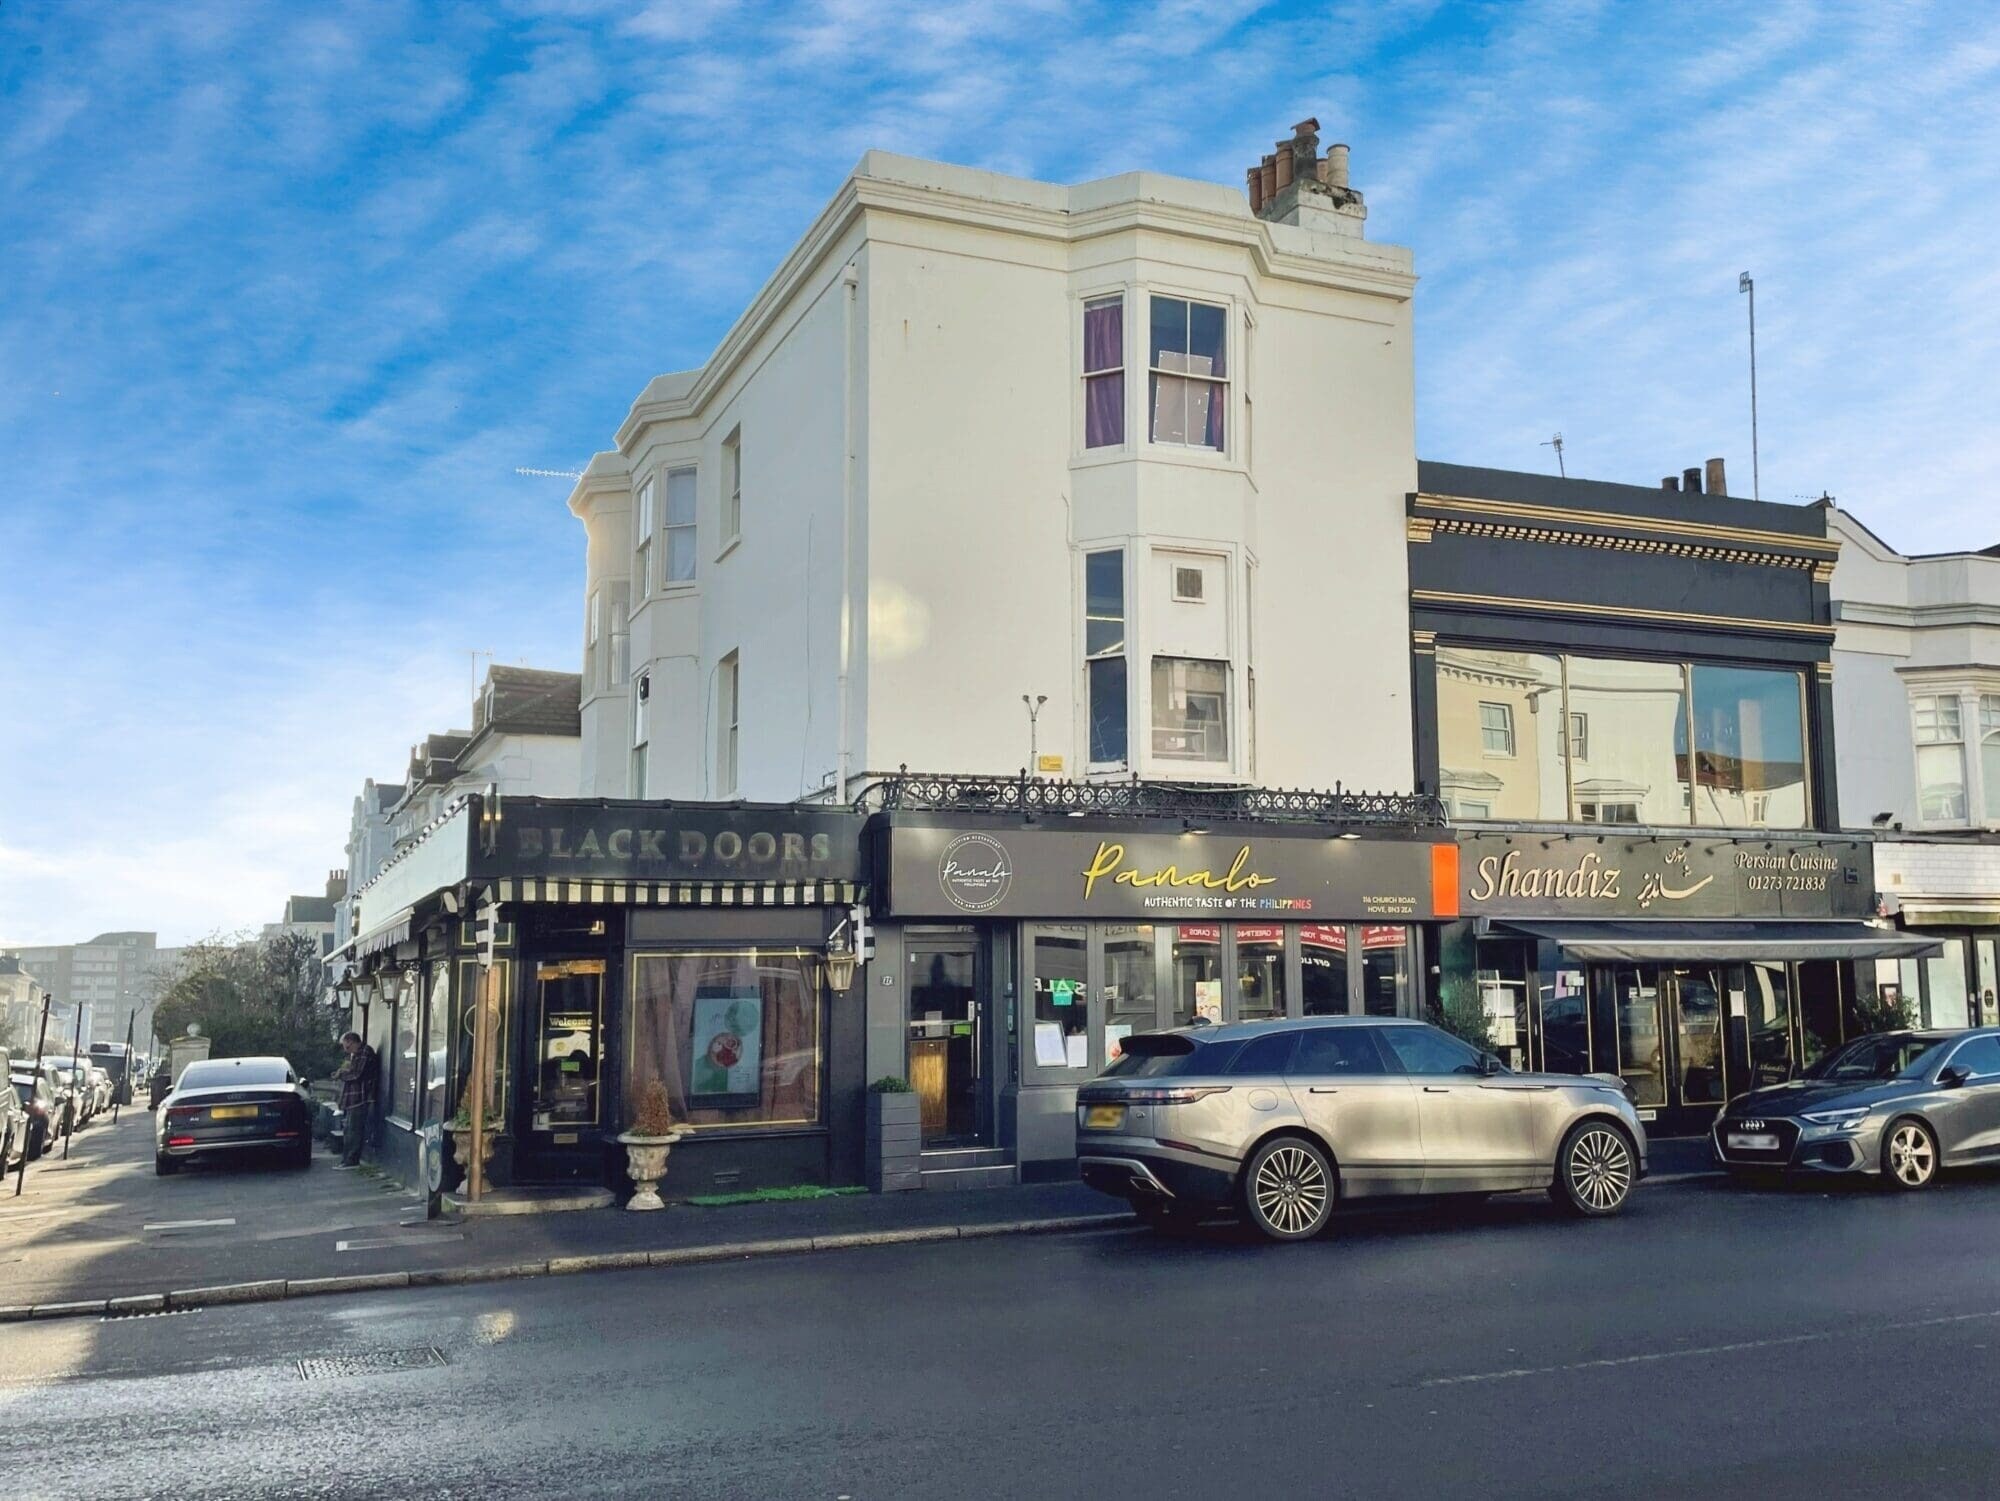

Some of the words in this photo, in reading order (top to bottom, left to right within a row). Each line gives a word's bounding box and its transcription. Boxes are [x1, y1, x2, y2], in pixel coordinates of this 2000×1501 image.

[517, 827, 666, 859] BLACK
[679, 829, 830, 863] DOORS
[942, 860, 1012, 881] Panalo
[1082, 841, 1277, 901] Panalo
[1736, 851, 1786, 869] Persian
[1789, 853, 1839, 872] Cuisine
[1470, 850, 1621, 901] Shandiz
[1748, 875, 1782, 890] 01273
[1786, 877, 1827, 891] 721838
[1144, 897, 1193, 907] AUTHENTIC
[1195, 898, 1223, 908] TASTE
[1225, 898, 1238, 908] OF
[1240, 898, 1257, 908] THE
[1259, 899, 1312, 909] PHILIPPINES
[1367, 906, 1387, 914] HOVE,
[549, 1016, 592, 1027] Welcome
